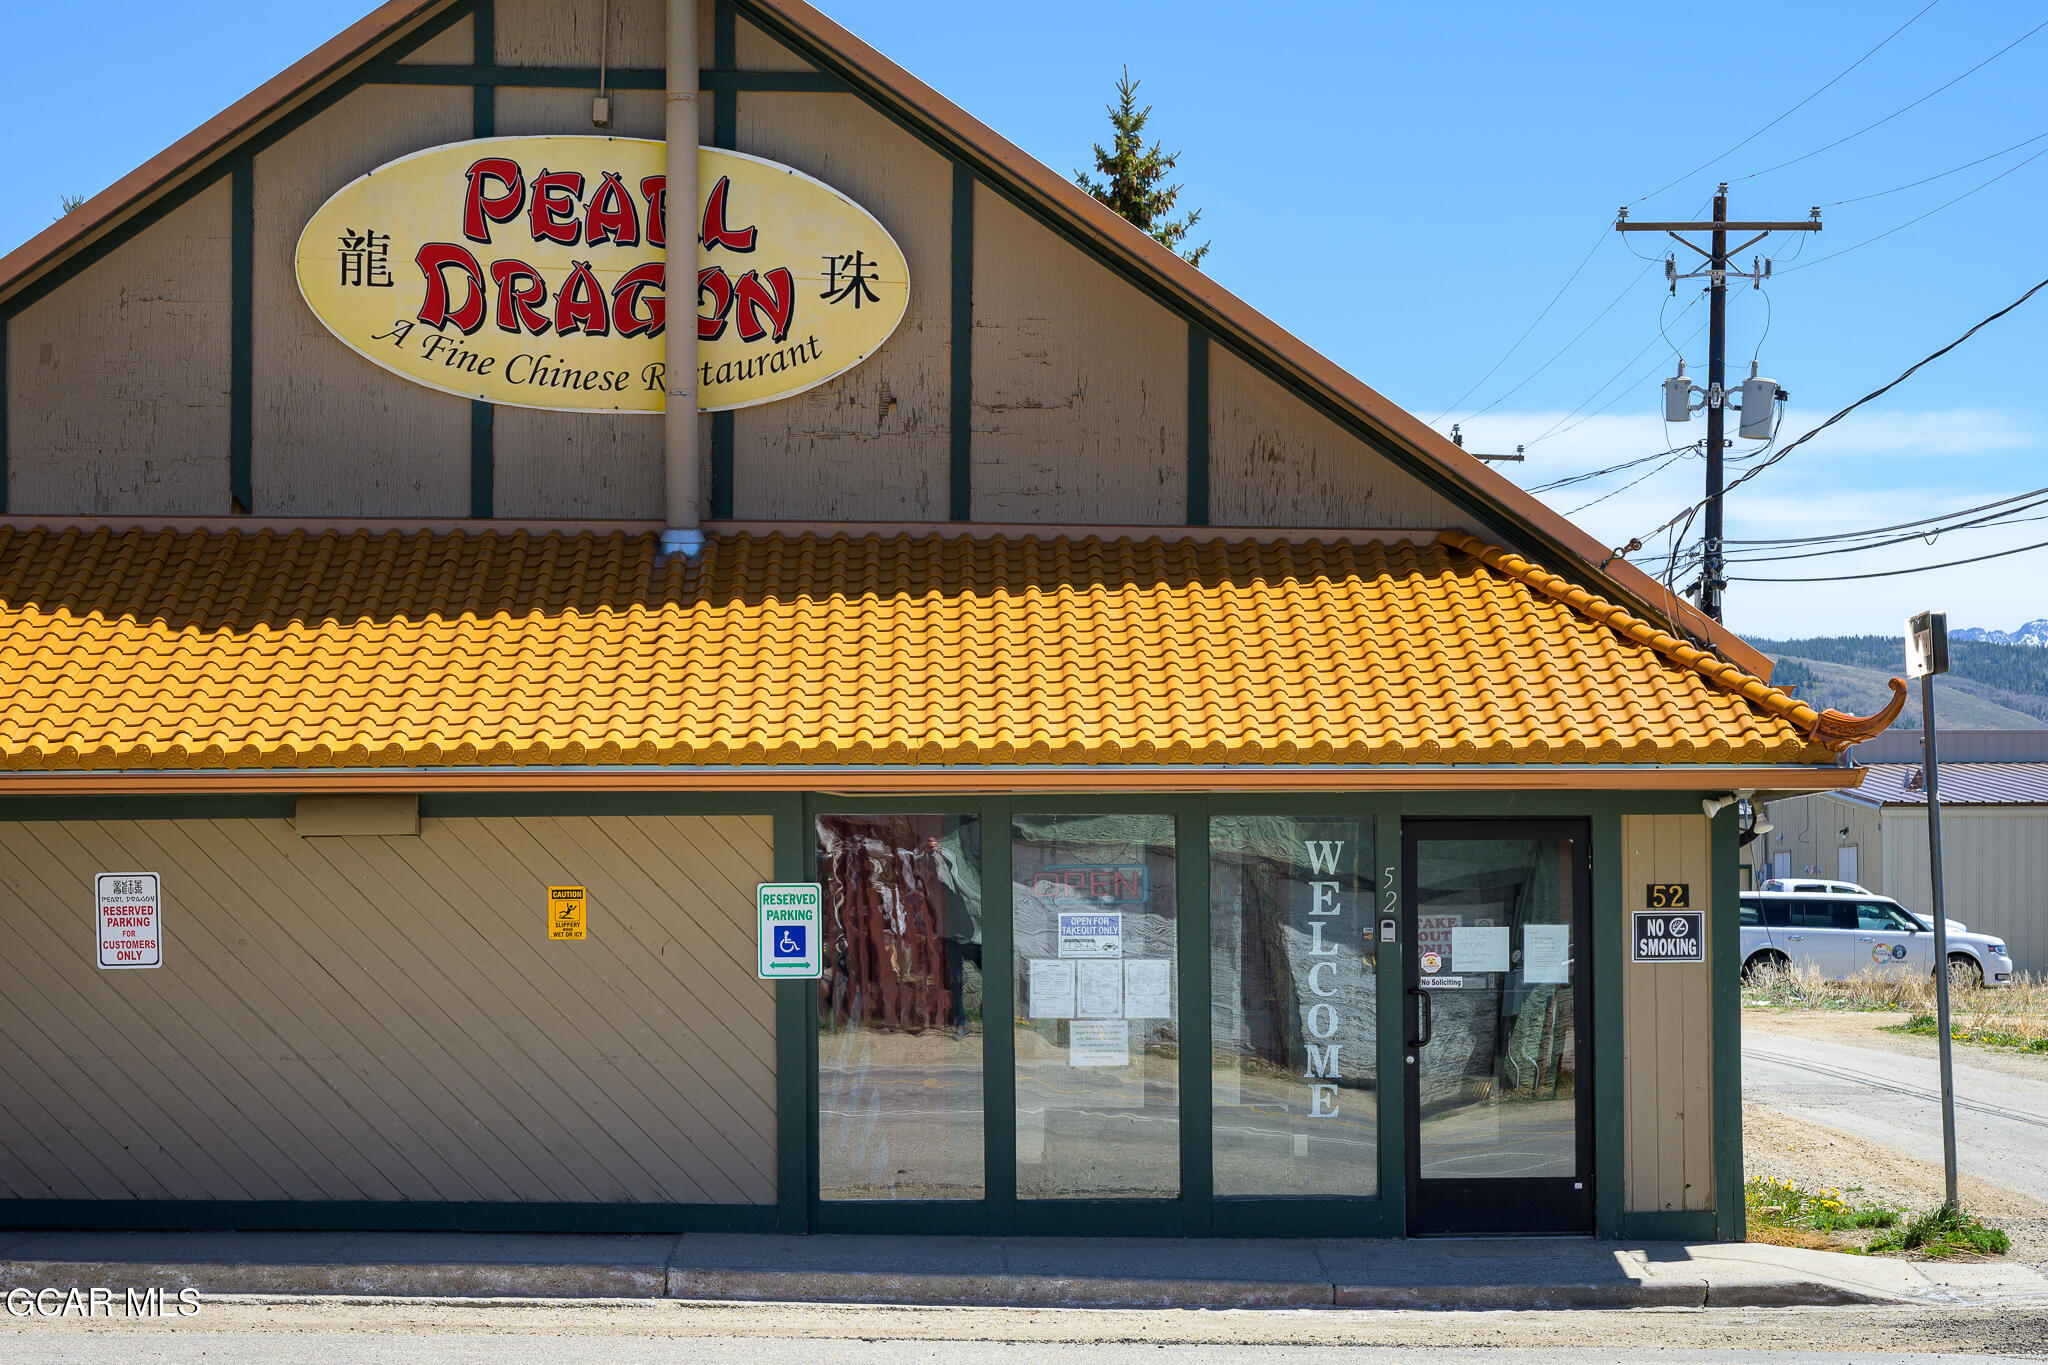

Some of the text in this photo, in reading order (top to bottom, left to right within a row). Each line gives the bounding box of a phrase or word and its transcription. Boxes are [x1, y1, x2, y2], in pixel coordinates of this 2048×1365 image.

[338, 228, 395, 288] 龍
[819, 249, 881, 310] 珠
[371, 319, 824, 392] A Fine Chinese Rtaurant
[1033, 871, 1139, 897] OPEN
[126, 895, 155, 903] DRAGON
[762, 893, 817, 905] RESERVED
[1652, 885, 1685, 908] 52
[103, 905, 154, 916] RESERVED
[766, 909, 813, 921] PARKING
[107, 917, 151, 928] PARKING
[1070, 916, 1109, 926] OPEN FOR
[1061, 926, 1120, 936] TAKEOUT ONLY
[1647, 918, 1665, 937] NO
[122, 930, 136, 938] FOR
[102, 940, 156, 950] CUSTOMERS
[1639, 938, 1697, 956] SMOKING
[116, 950, 143, 961] ONLY
[1304, 840, 1345, 1119] WELCOME
[1421, 978, 1462, 987] No Soliciting
